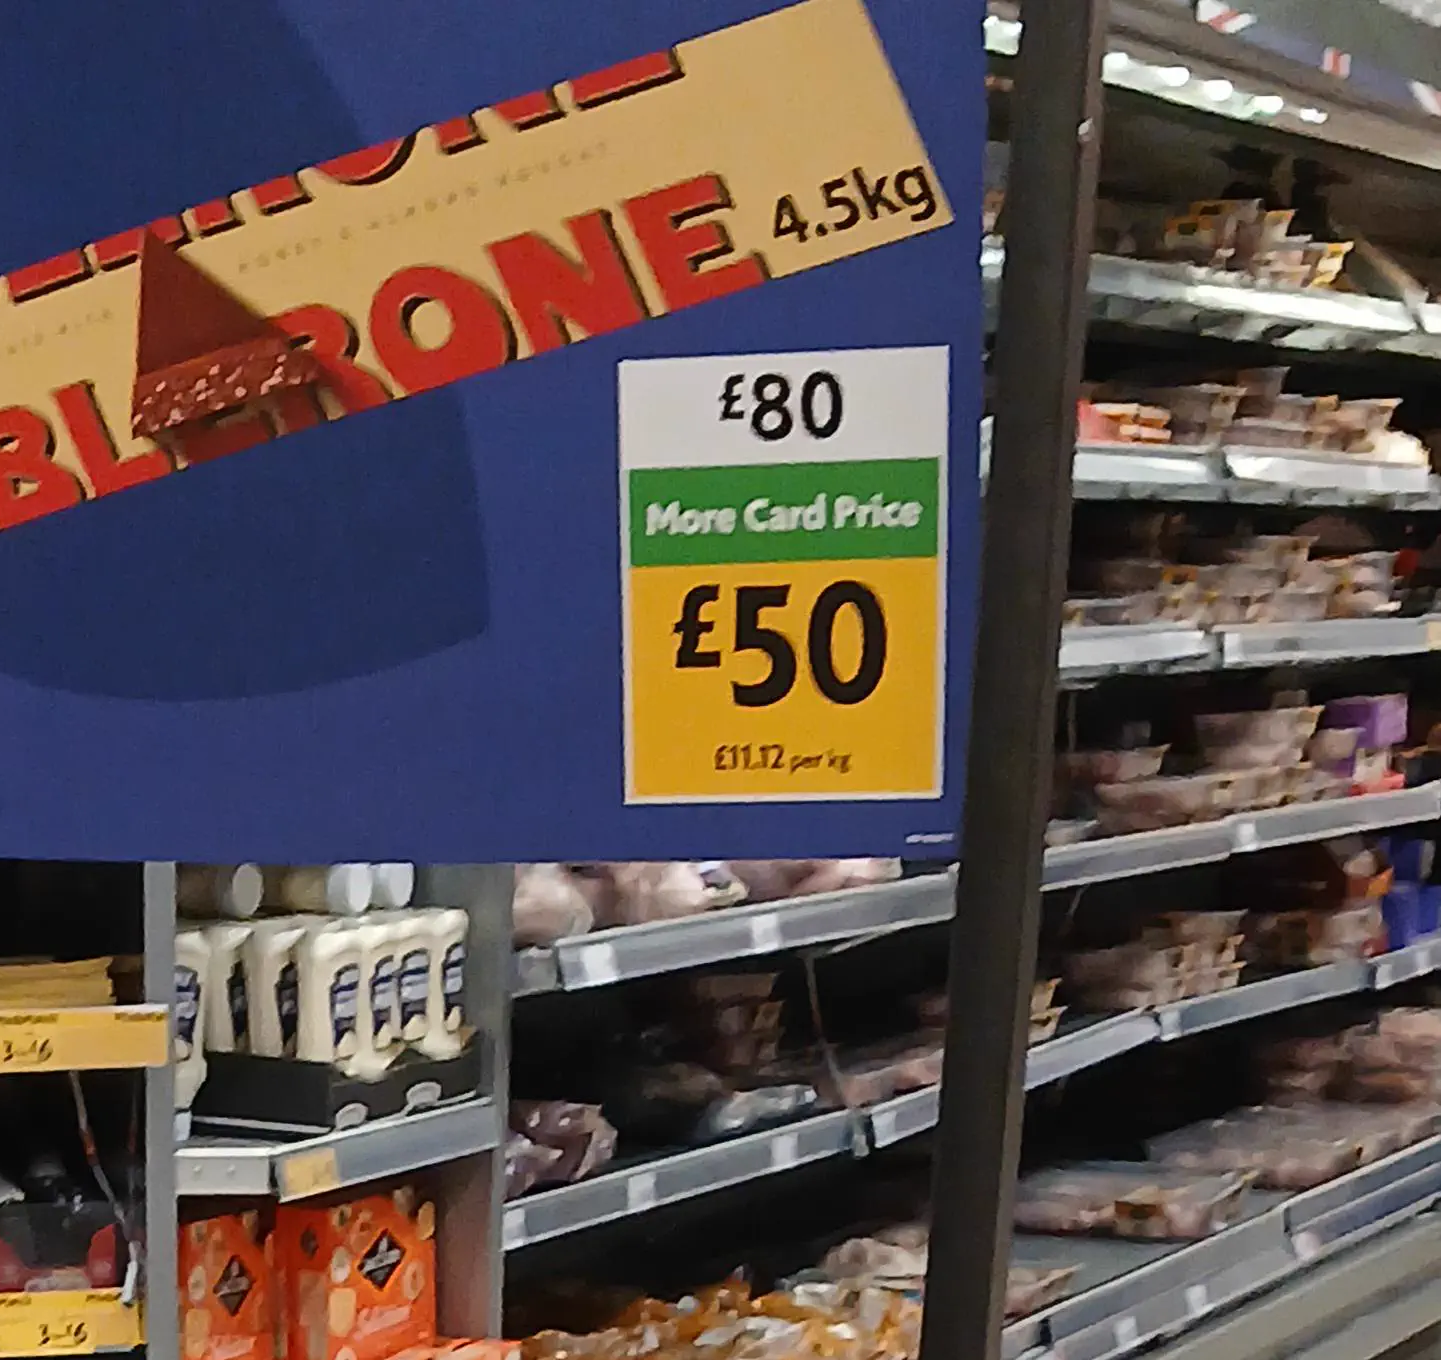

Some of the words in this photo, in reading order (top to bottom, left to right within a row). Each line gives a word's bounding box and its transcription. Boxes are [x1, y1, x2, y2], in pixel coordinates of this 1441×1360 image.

[772, 165, 938, 244] 4.5kg
[718, 369, 843, 442] £80
[645, 500, 737, 537] More
[743, 492, 828, 533] Card
[833, 492, 924, 530] Price
[672, 579, 888, 709] £50
[714, 742, 786, 771] £11.12
